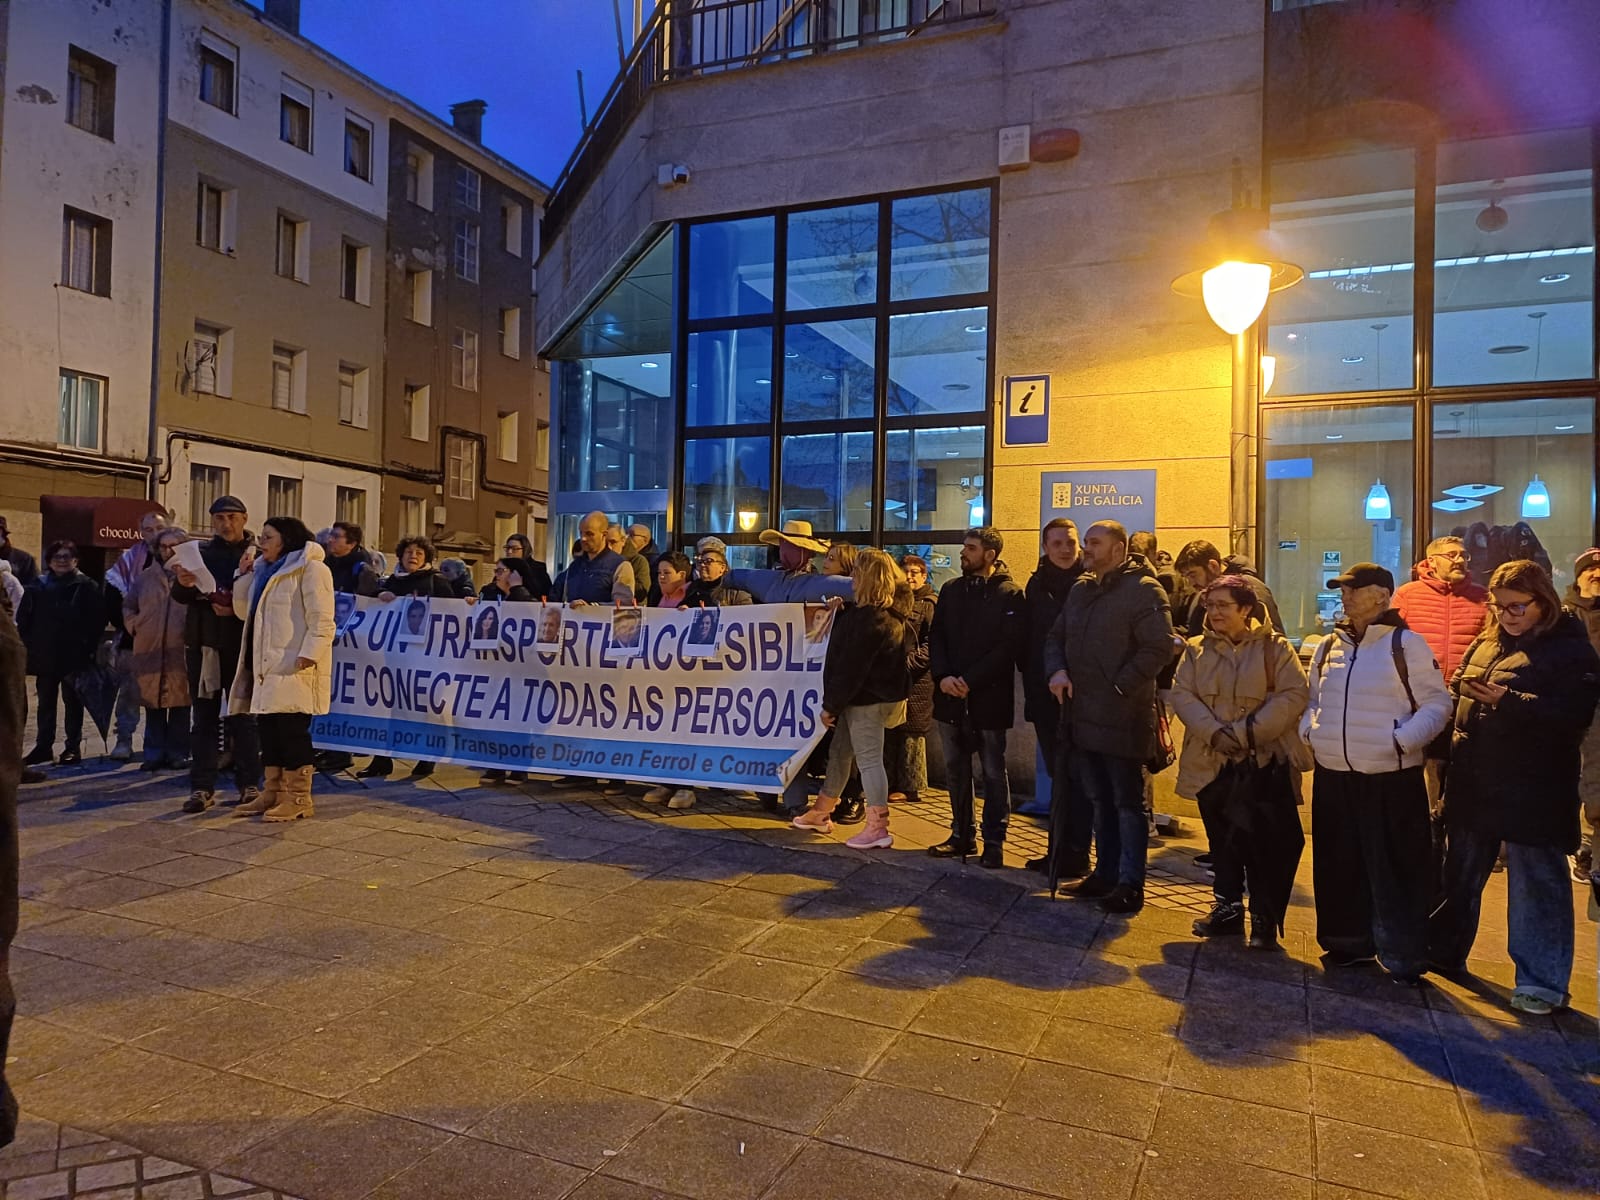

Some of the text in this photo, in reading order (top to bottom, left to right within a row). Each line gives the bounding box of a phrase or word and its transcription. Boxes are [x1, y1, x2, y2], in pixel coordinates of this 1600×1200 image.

[1074, 484, 1118, 494] XUNTA
[1074, 495, 1143, 506] DE GALICIA
[424, 613, 618, 669] TRASPRTE
[363, 664, 490, 719] CONECTE
[489, 676, 511, 721] A
[521, 678, 618, 729] TODAS
[622, 685, 664, 732] AS
[671, 686, 819, 739] PERSOAS
[311, 718, 388, 742] lataforma
[392, 731, 420, 748] por
[425, 733, 446, 749] un
[451, 733, 547, 760] Transporte
[551, 743, 606, 767] Digno
[610, 752, 634, 767] en
[638, 750, 697, 772] Ferrol
[701, 758, 713, 773] e
